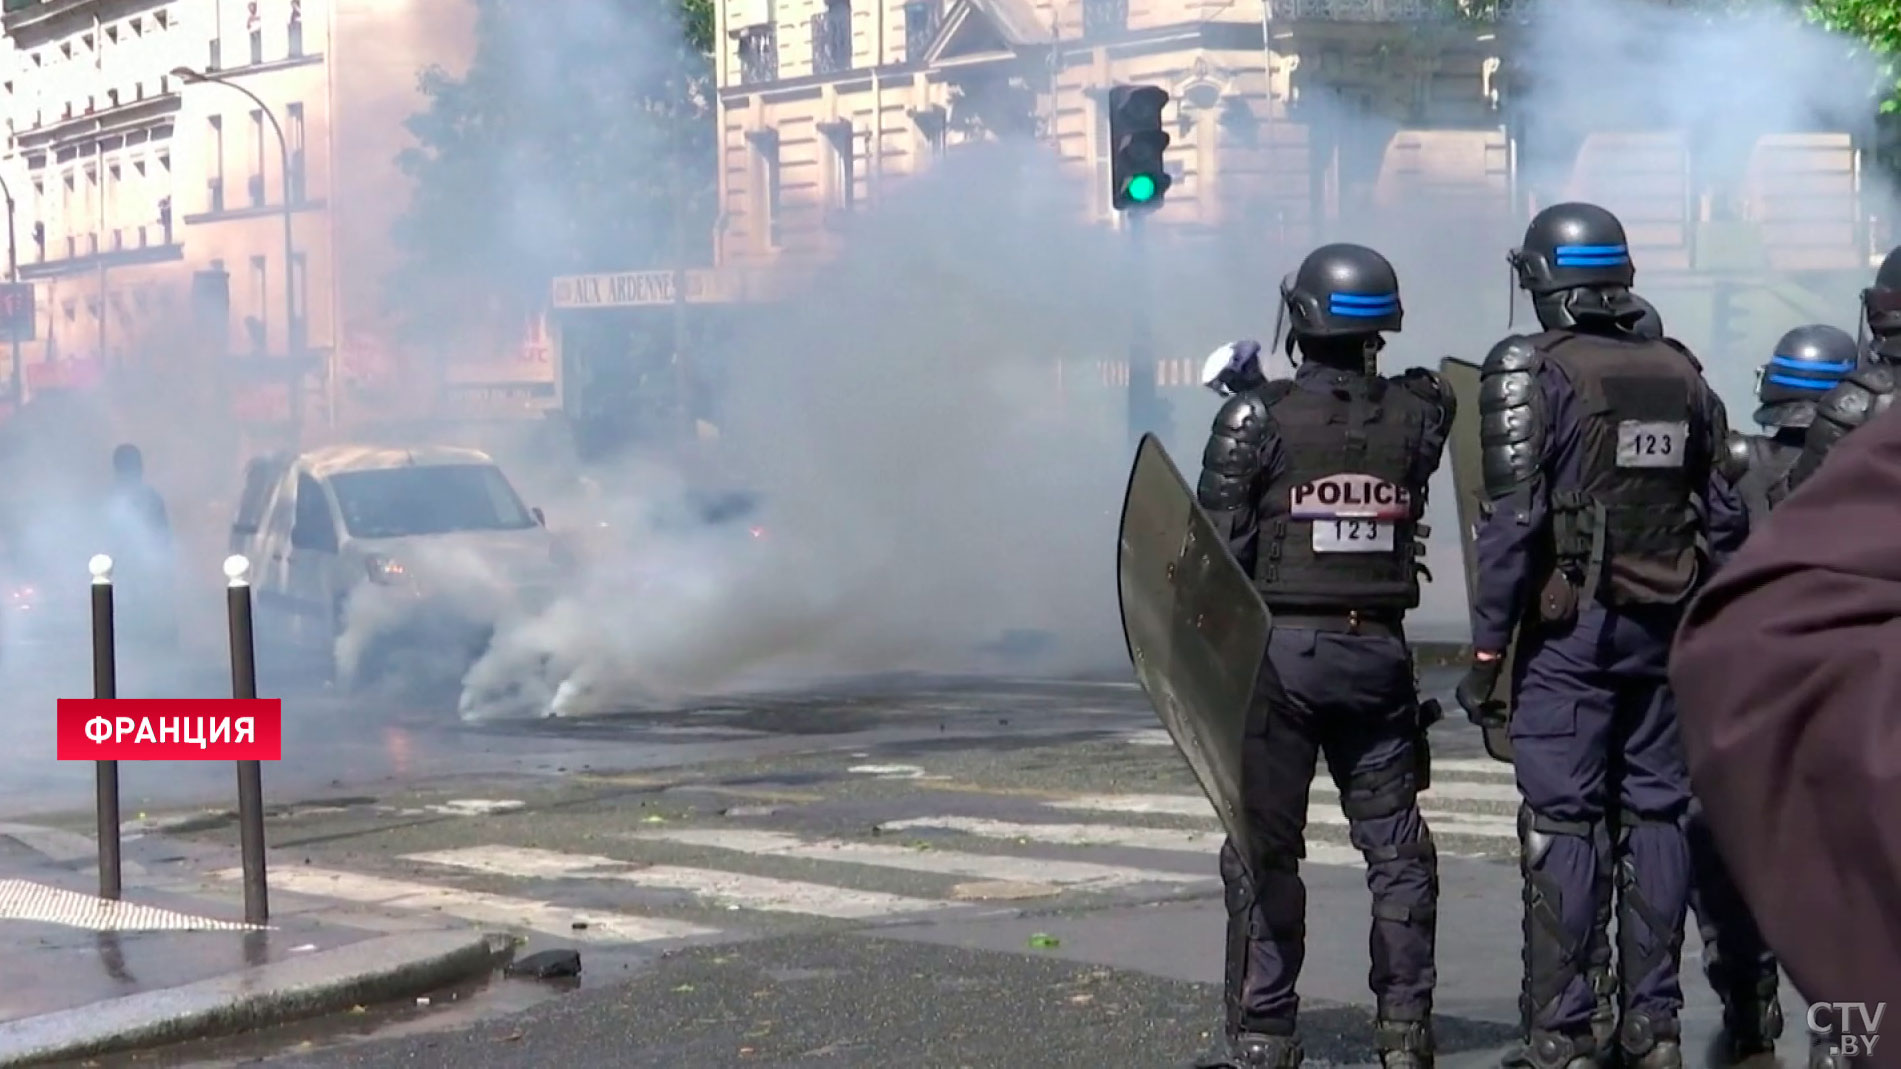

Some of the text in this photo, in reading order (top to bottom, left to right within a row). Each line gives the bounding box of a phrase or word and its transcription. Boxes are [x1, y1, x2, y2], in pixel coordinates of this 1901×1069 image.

[574, 276, 602, 304] AUX
[1634, 434, 1671, 455] 123
[1295, 481, 1409, 505] POLICE
[1334, 519, 1378, 541] 123
